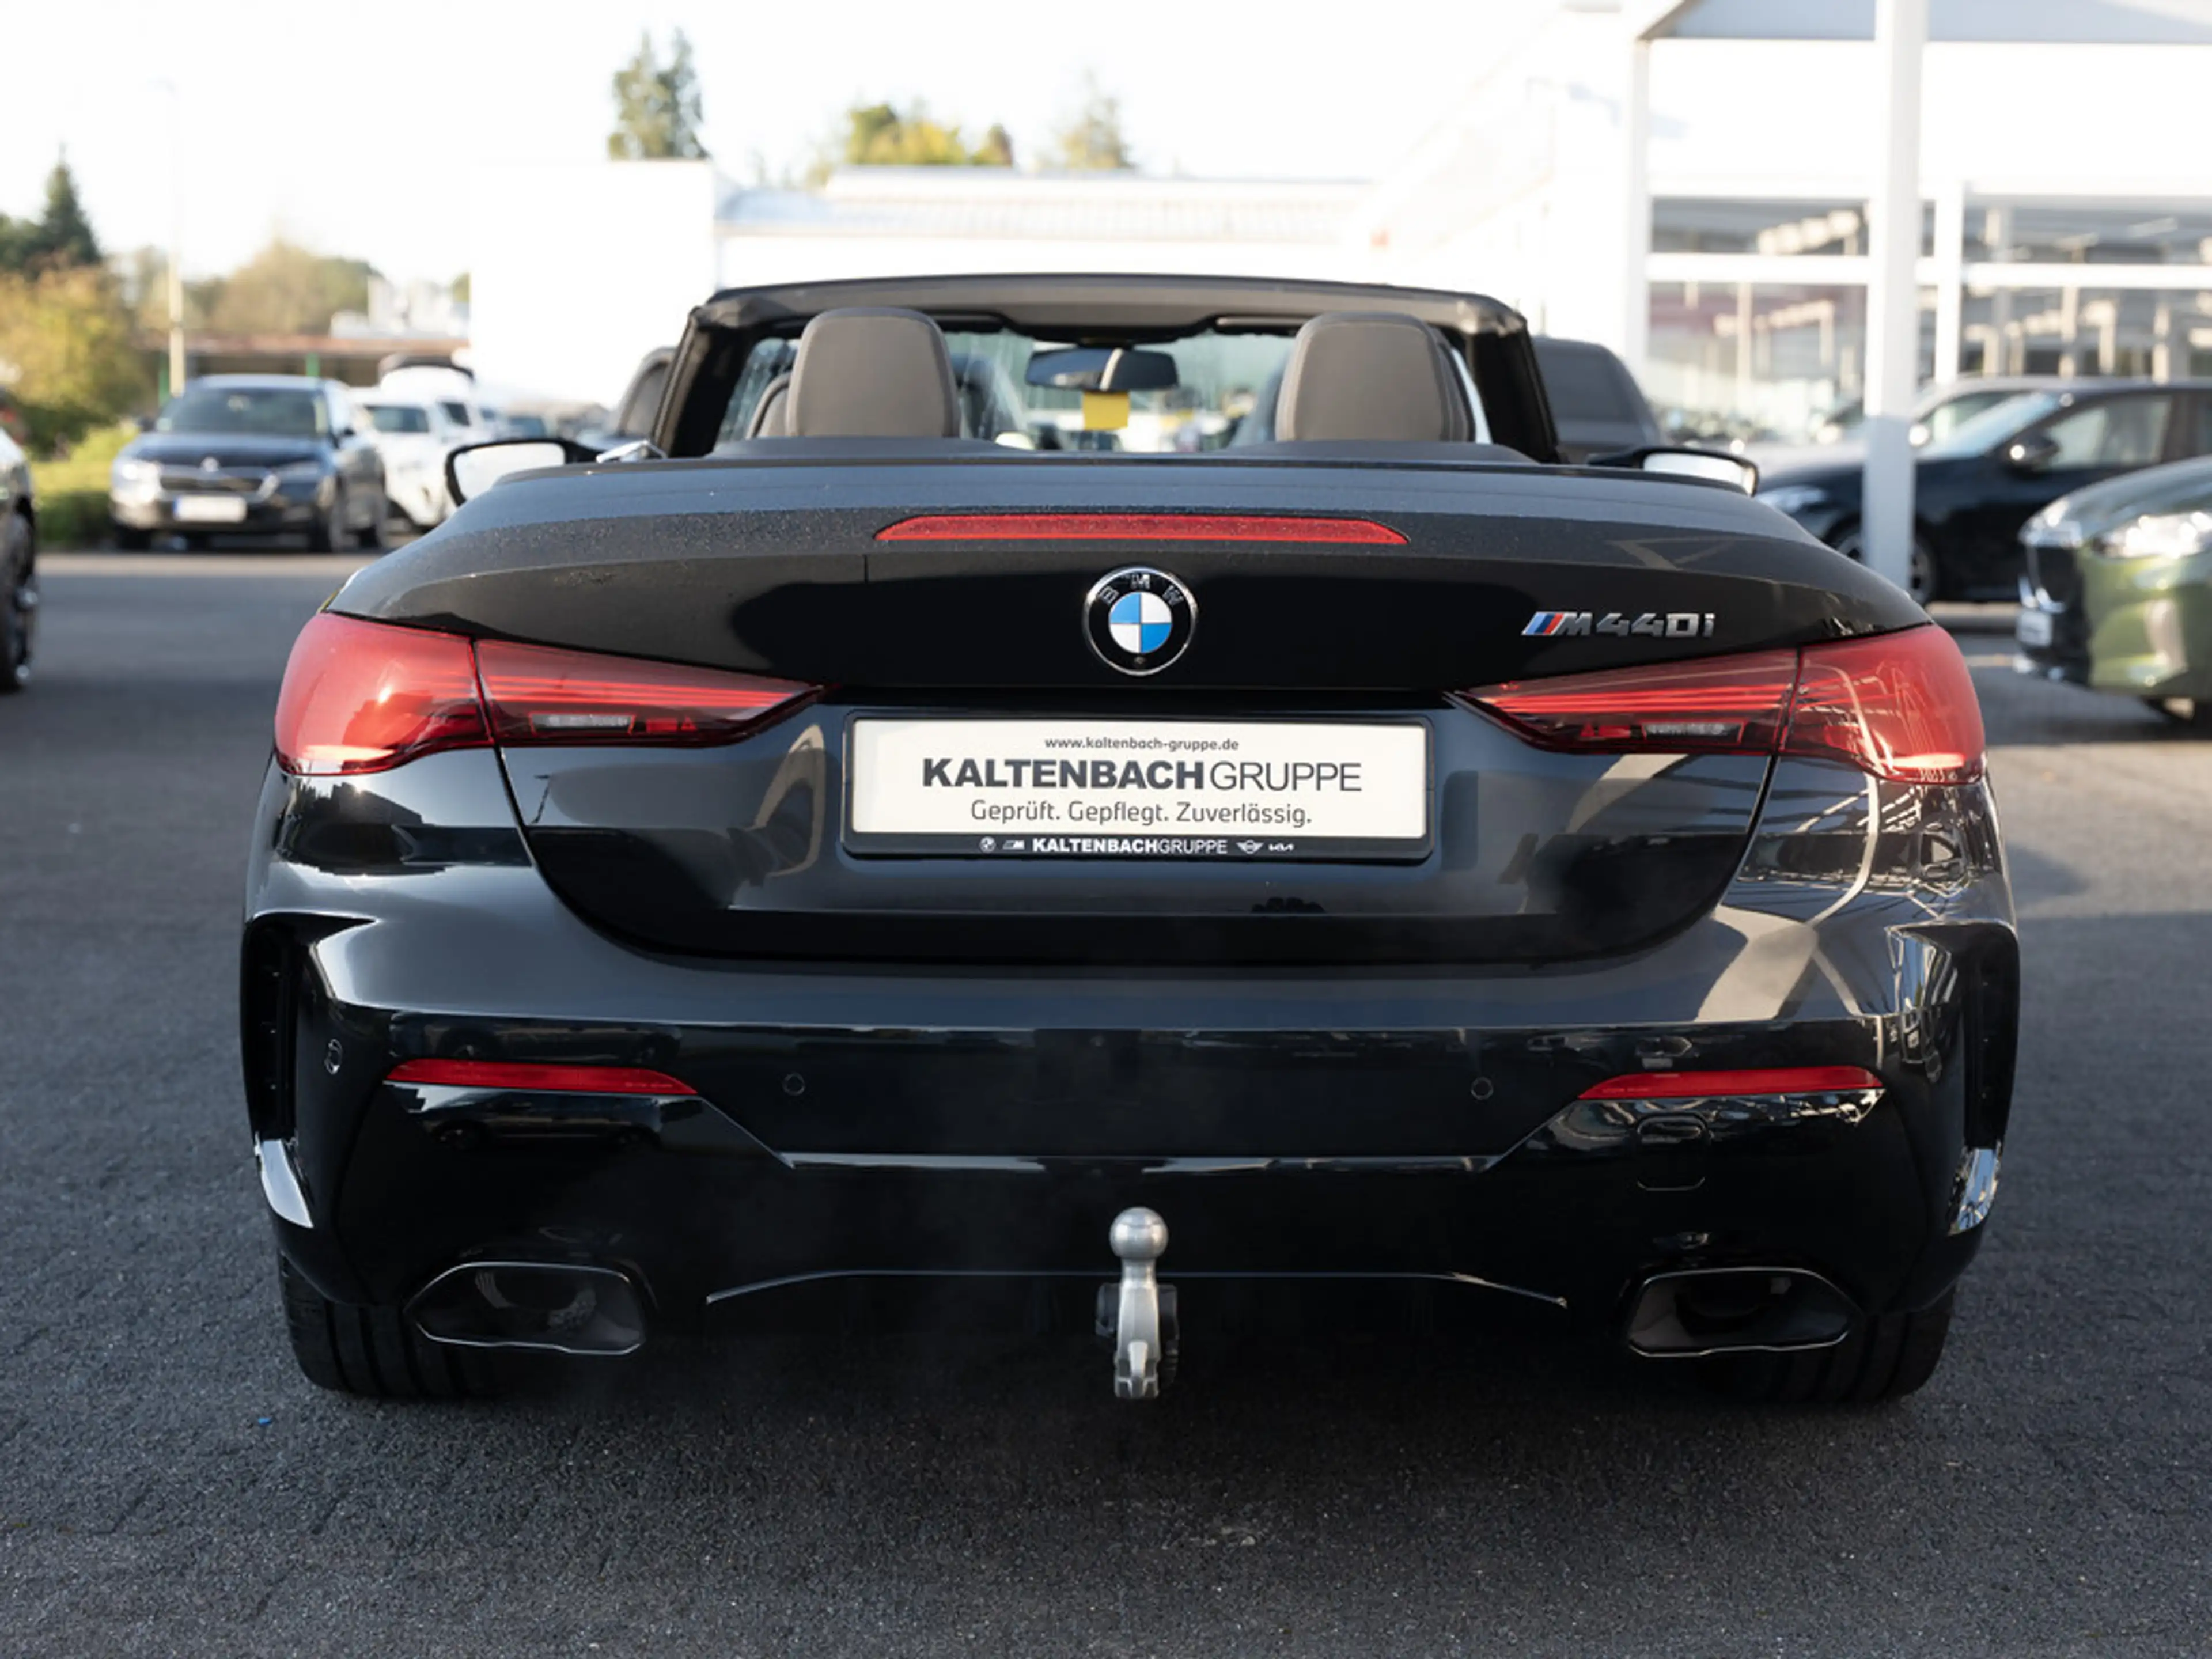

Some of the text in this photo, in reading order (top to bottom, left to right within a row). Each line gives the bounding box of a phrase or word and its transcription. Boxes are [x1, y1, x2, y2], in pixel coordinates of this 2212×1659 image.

[1097, 574, 1184, 605] BMW
[1044, 737, 1239, 752] www.kaltenbach-gruppe.de
[971, 799, 1312, 828] Geprüft. Gepflegt. Zuverlässig.
